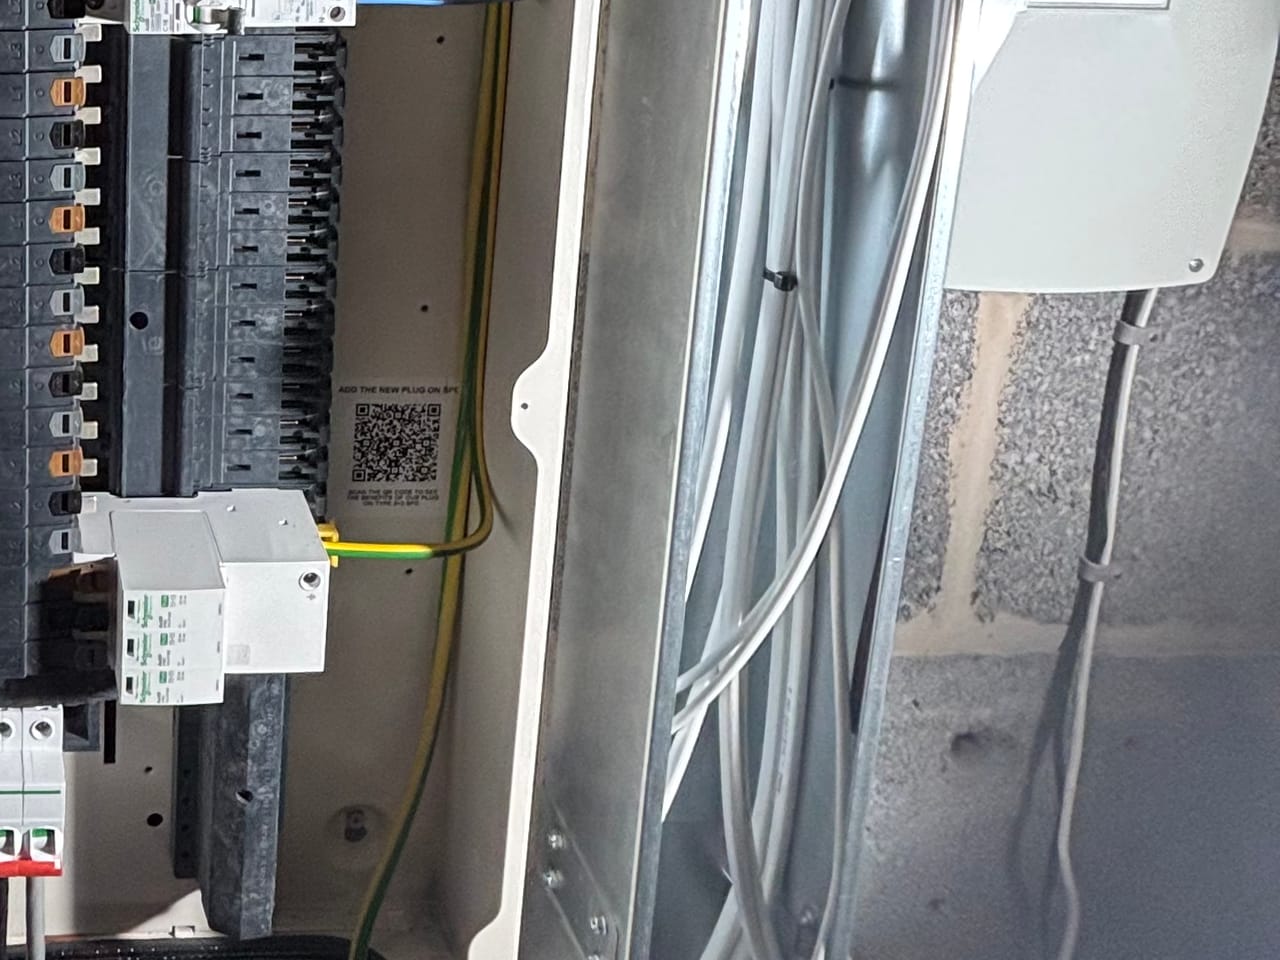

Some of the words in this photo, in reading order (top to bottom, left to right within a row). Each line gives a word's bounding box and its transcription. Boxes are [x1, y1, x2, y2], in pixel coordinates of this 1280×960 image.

[360, 385, 377, 394] THE
[379, 385, 400, 394] NEW
[401, 385, 425, 394] PLUG
[428, 385, 440, 394] ON
